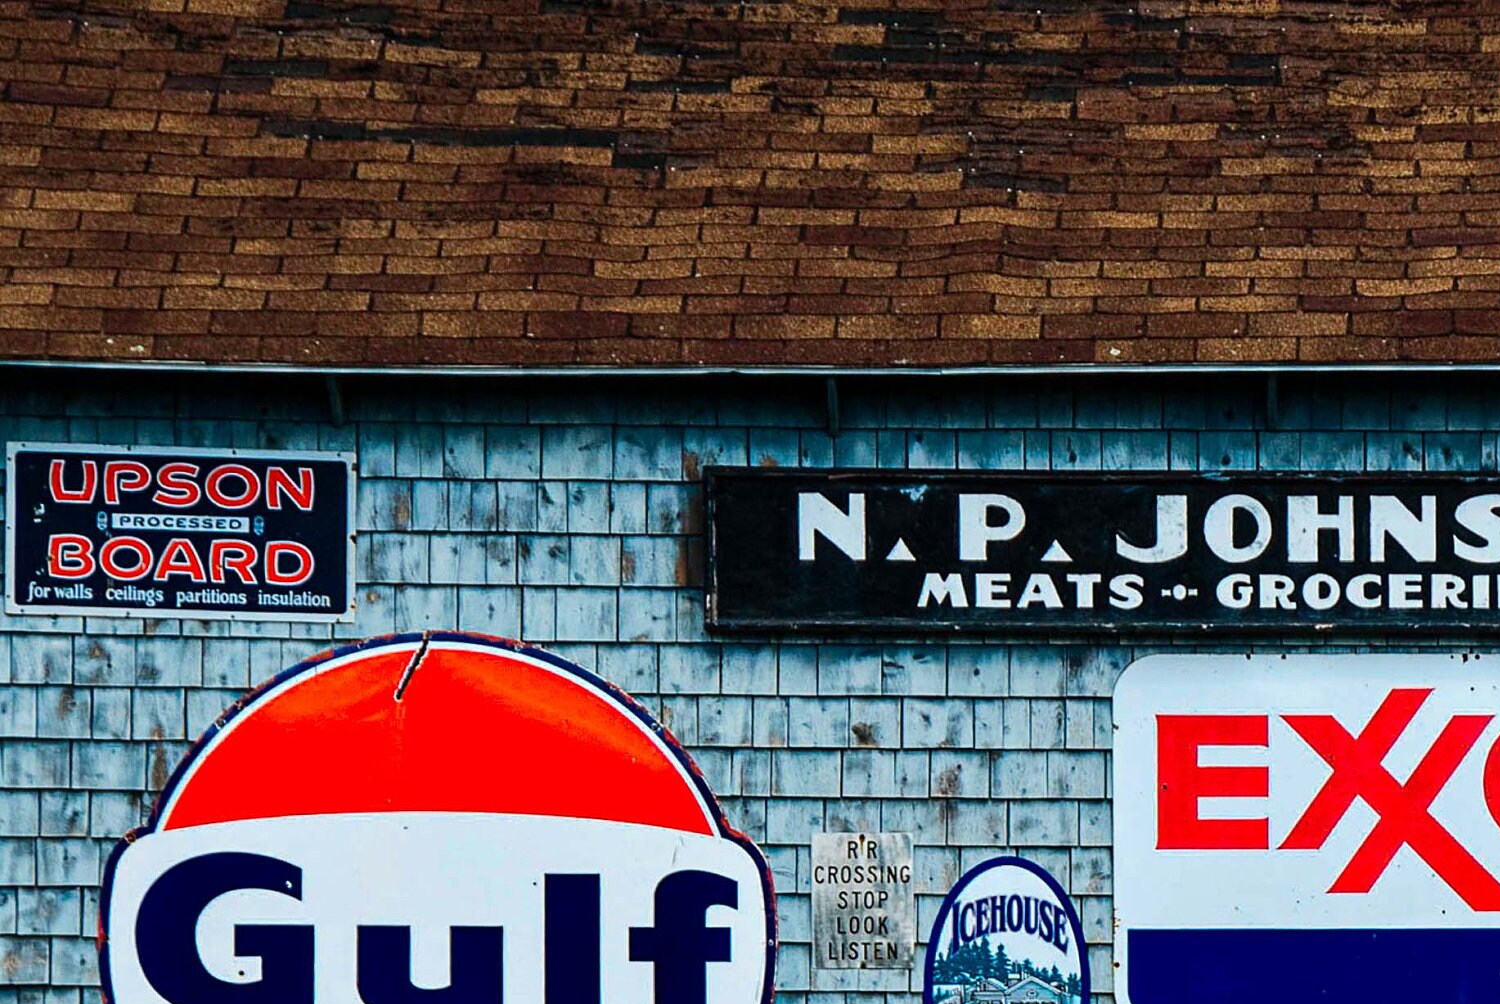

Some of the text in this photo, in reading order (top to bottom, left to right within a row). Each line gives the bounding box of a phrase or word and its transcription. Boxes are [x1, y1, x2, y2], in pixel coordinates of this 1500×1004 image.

[49, 459, 314, 511] UPSON
[119, 515, 242, 530] PROCESSED
[799, 492, 916, 562] N.
[959, 493, 1072, 562] P.
[48, 534, 314, 586] BOARD
[27, 581, 331, 608] for walls ceilings partitions insulation
[916, 573, 1145, 609] MEATS
[814, 865, 911, 885] CROSSING
[837, 890, 889, 910] STOP
[837, 916, 888, 935] LOOK
[952, 894, 1069, 954] ICEHOUSE
[828, 942, 899, 961] LISTEN
